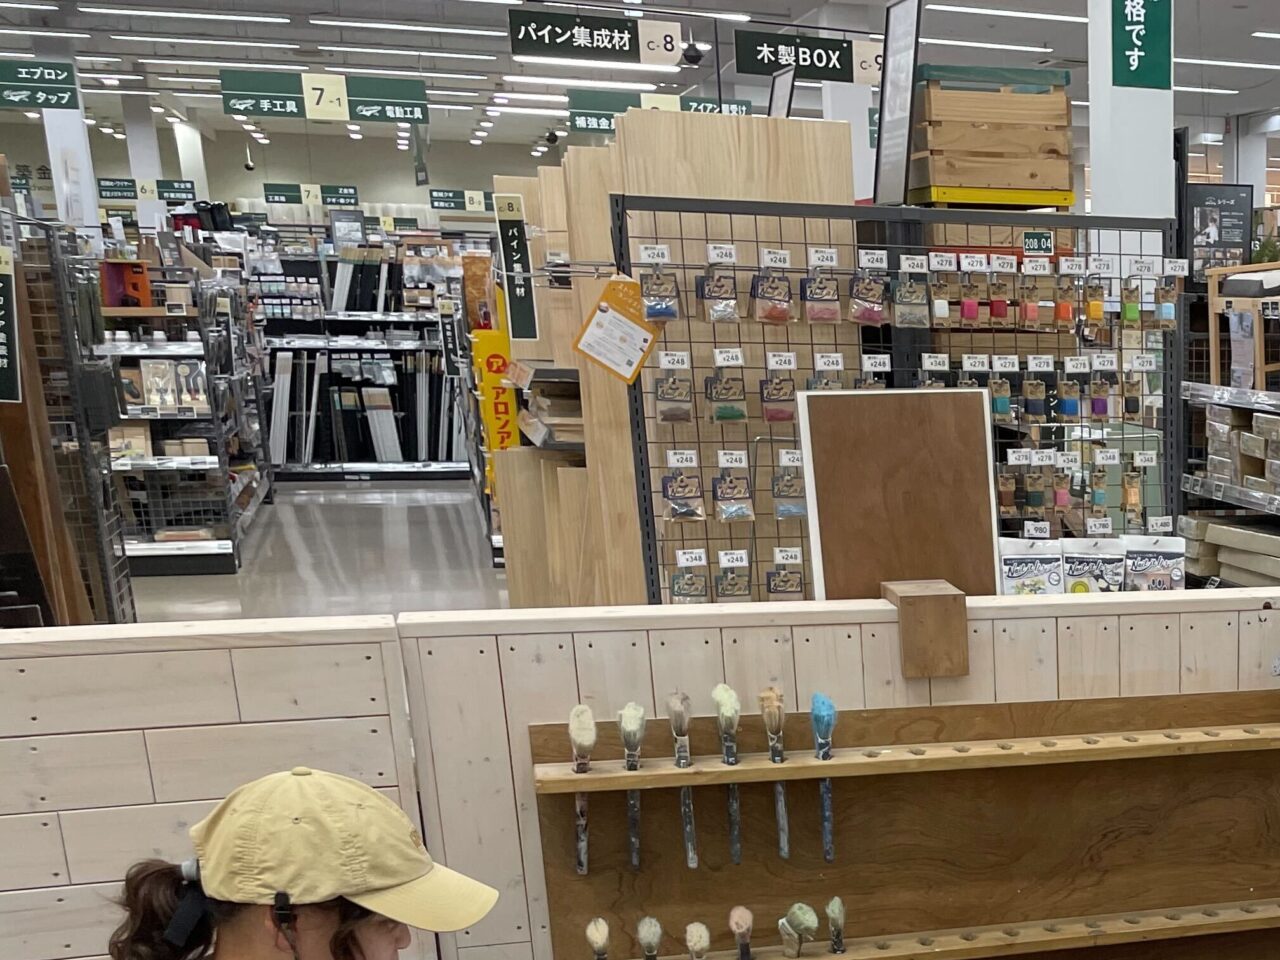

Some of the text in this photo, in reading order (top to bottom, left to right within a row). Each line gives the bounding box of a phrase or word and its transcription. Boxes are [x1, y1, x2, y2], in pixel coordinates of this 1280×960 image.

[517, 22, 631, 50] パイン集成材
[756, 42, 841, 69] 木製BOX
[17, 68, 68, 80] エプロン
[36, 92, 71, 104] タップ
[260, 100, 298, 113] 手工具
[385, 106, 423, 119] 電動工具
[508, 228, 526, 297] パイン集成材
